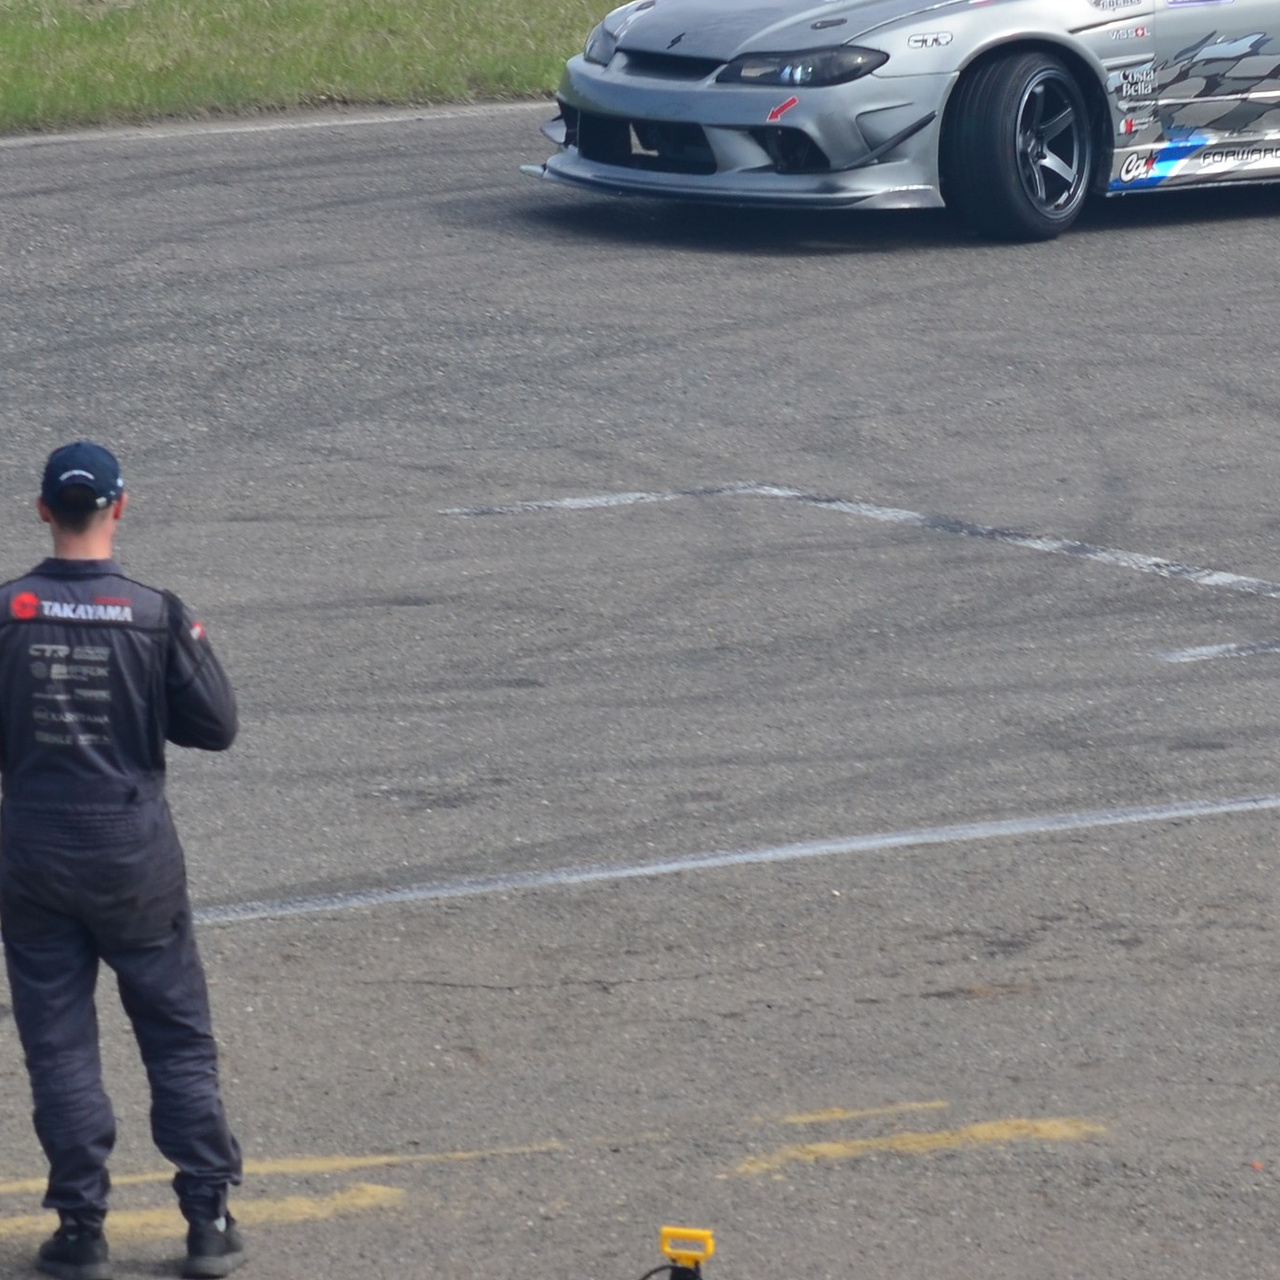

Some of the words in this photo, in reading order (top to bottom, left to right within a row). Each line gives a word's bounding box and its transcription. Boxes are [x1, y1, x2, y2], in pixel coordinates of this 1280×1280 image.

[1120, 69, 1154, 84] Costa
[1122, 81, 1152, 97] Bella
[41, 600, 133, 622] TAKAYAMA
[29, 644, 70, 658] CTR
